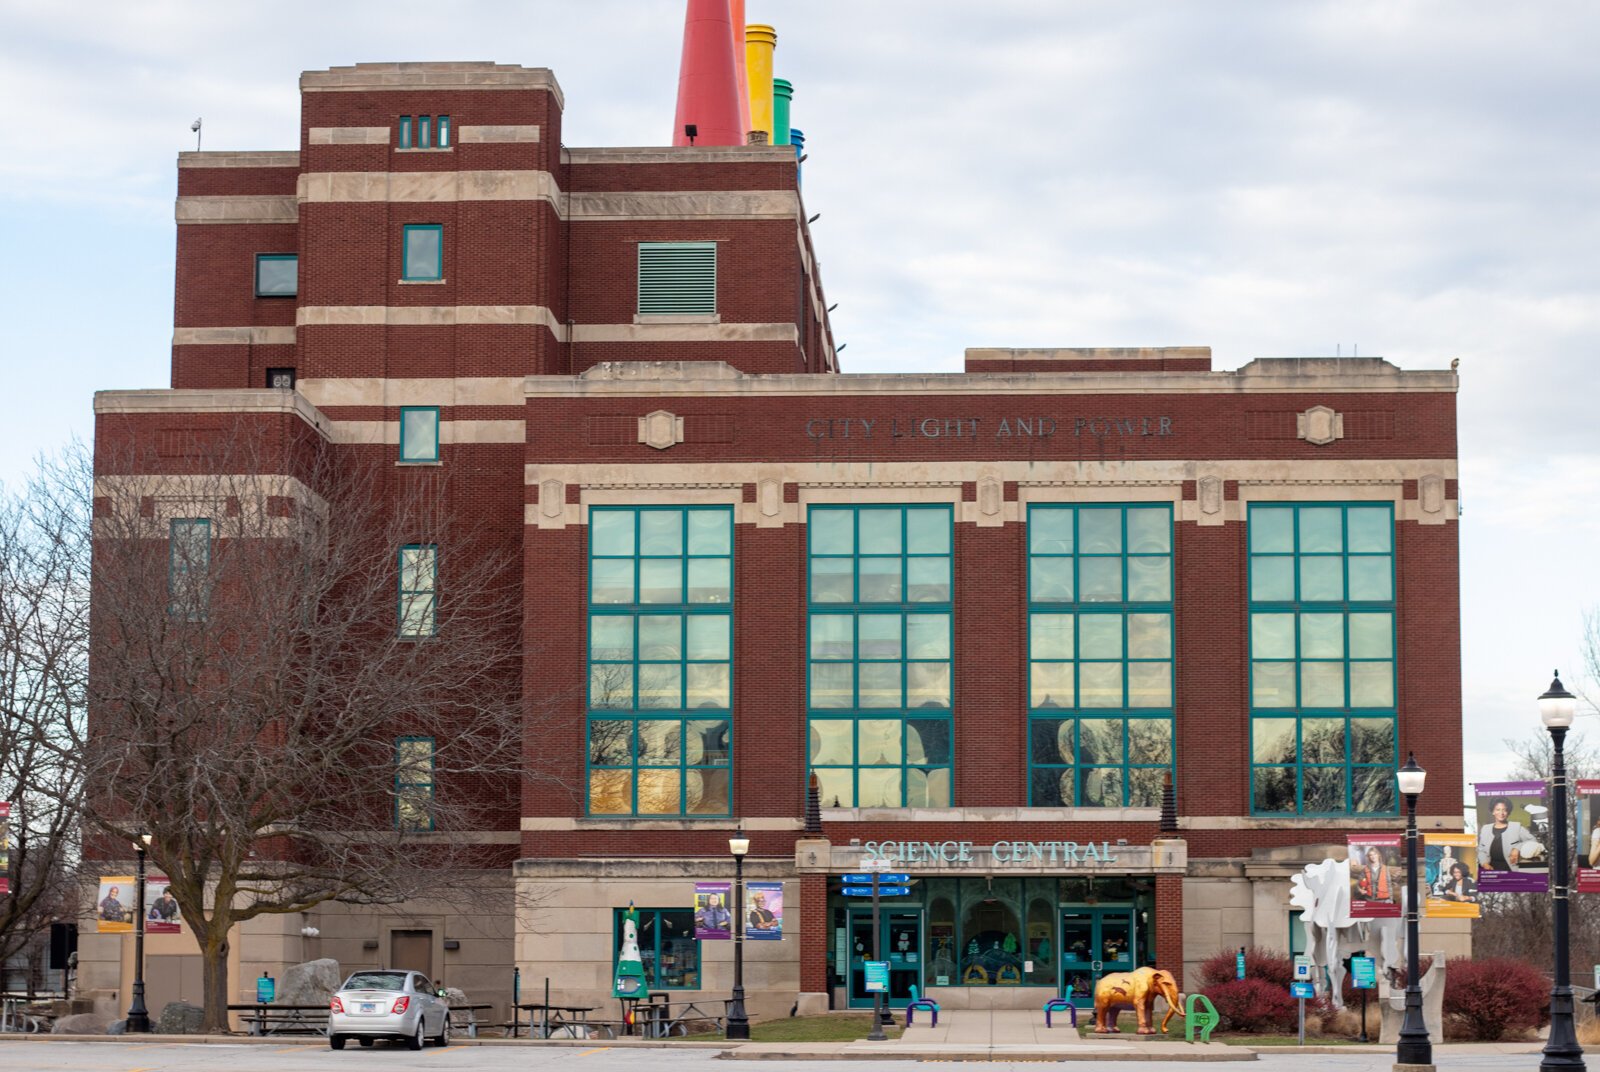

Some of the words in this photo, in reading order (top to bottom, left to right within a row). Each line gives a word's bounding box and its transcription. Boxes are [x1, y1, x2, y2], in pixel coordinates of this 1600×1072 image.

[806, 418, 876, 439] CITY
[893, 418, 981, 438] LIGHT
[996, 418, 1056, 437] AND
[1074, 416, 1174, 437] POWER
[864, 840, 974, 862] SCIENCE
[991, 840, 1118, 862] CENTRAL
